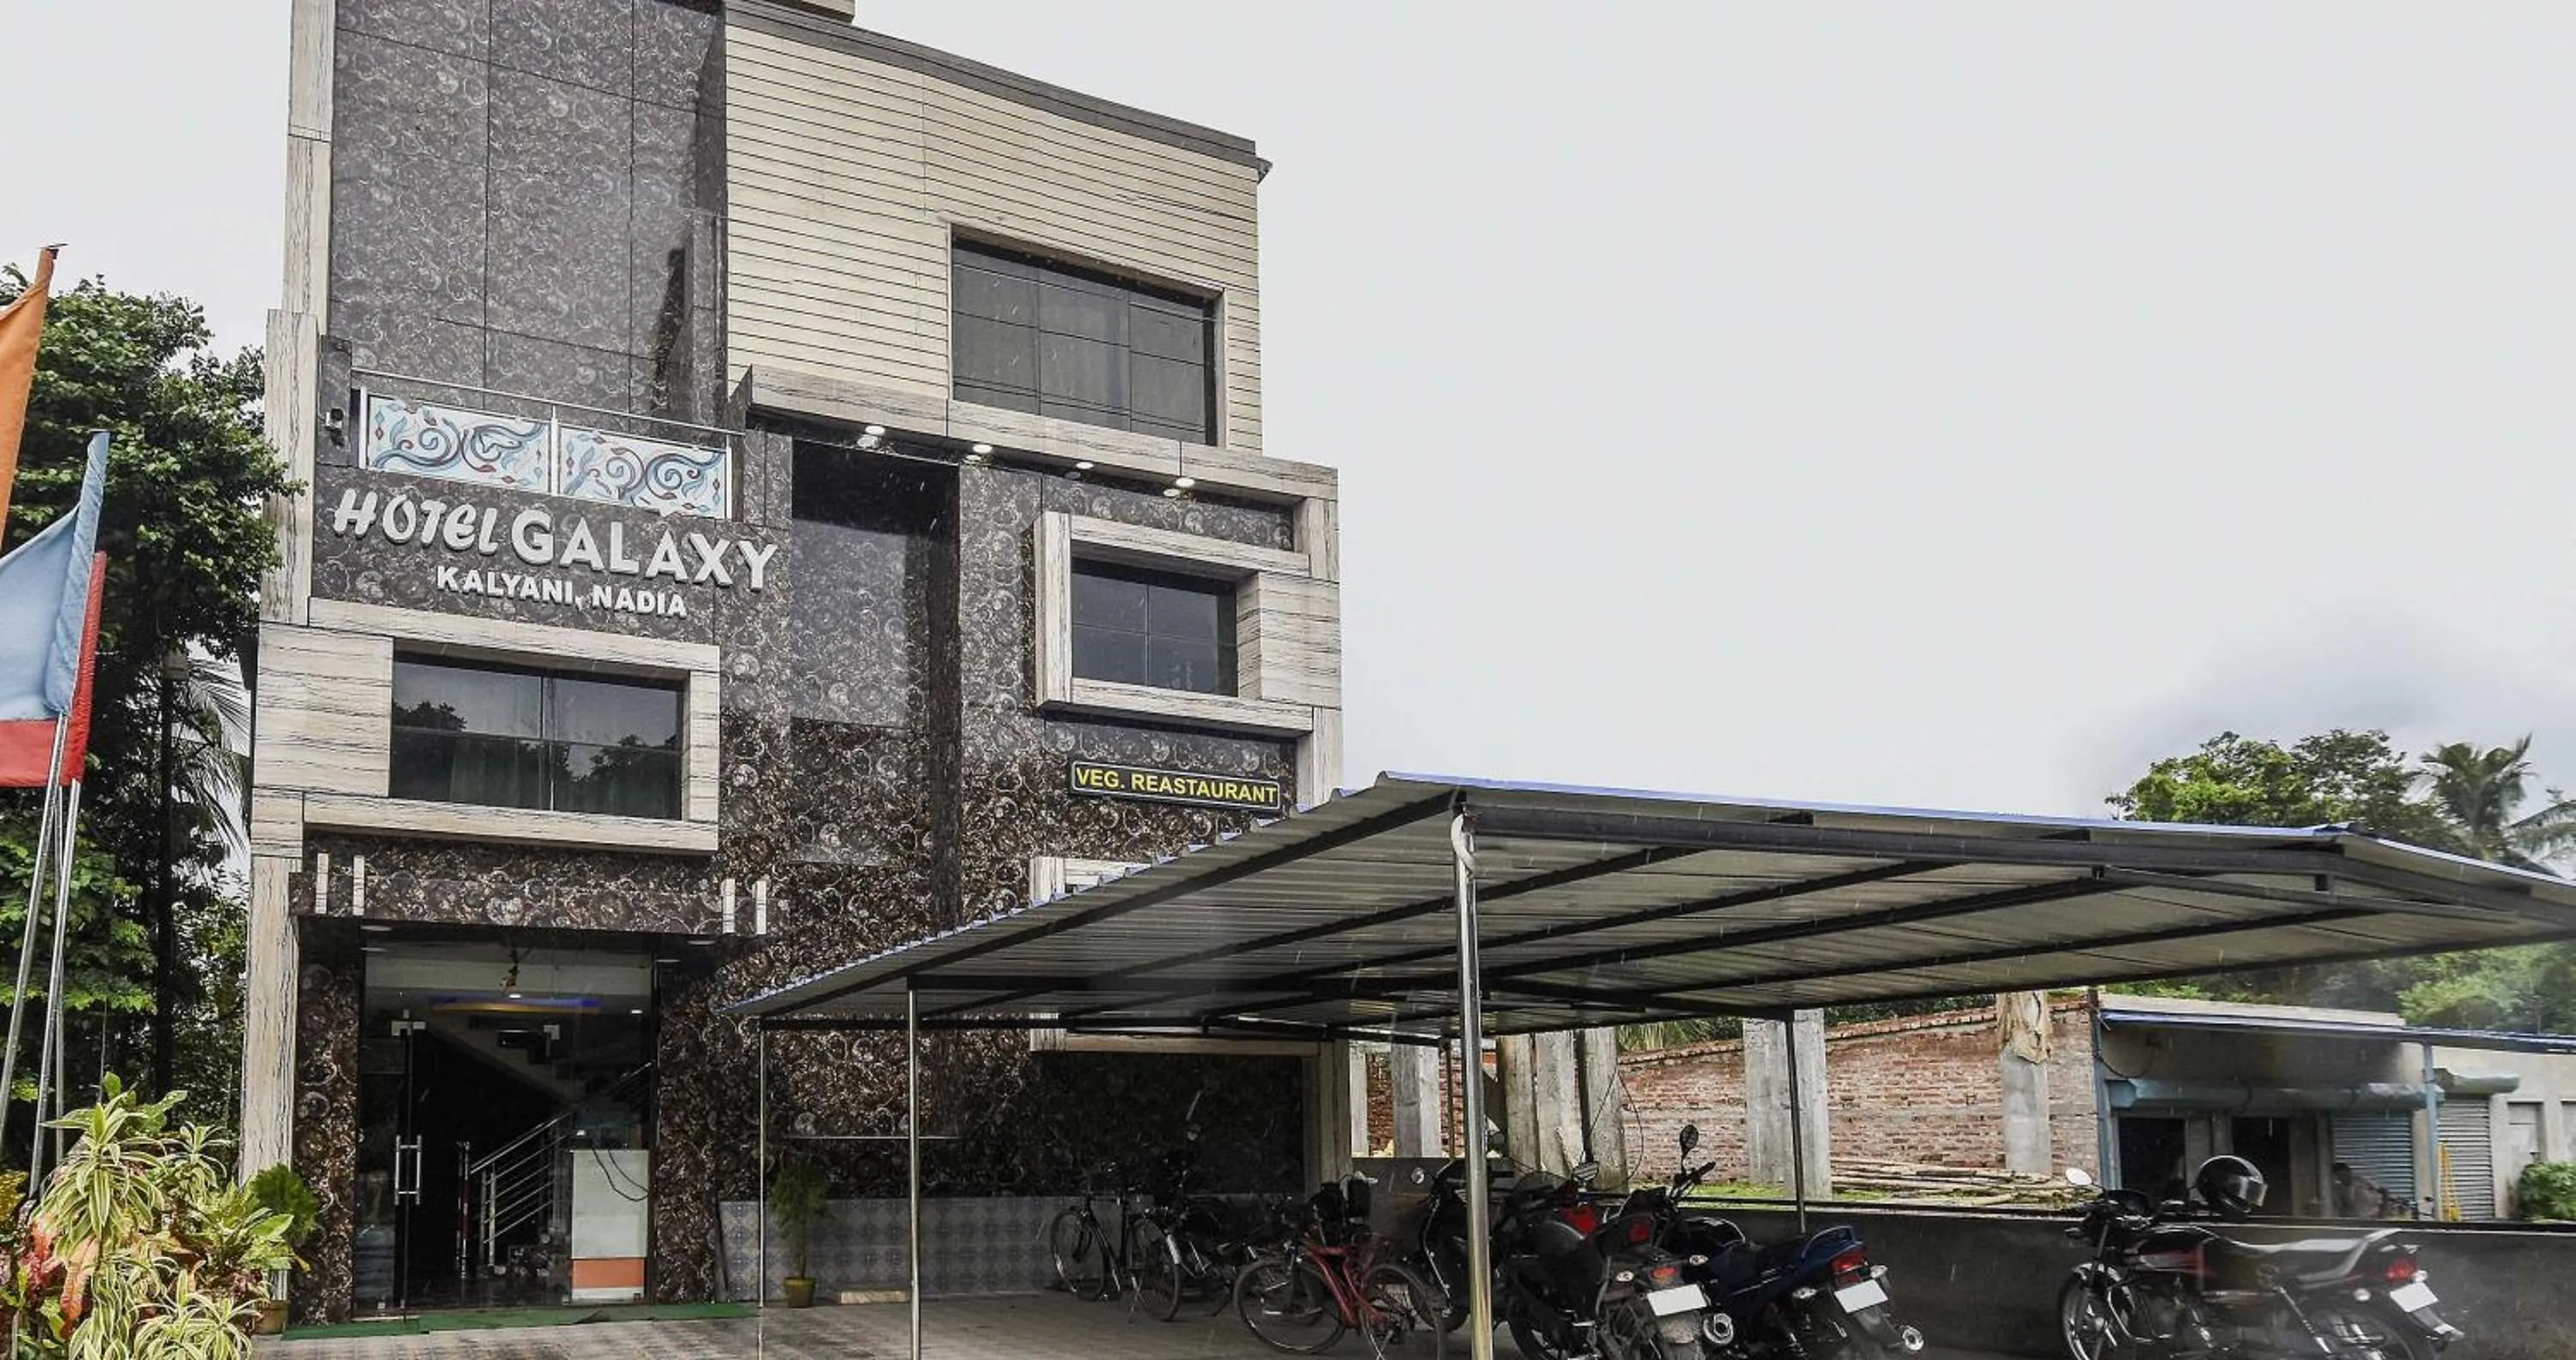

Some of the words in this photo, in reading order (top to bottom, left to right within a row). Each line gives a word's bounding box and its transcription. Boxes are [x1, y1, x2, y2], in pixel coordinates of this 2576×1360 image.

[510, 509, 777, 591] GALAXY
[436, 565, 584, 611] KALYANI,
[591, 586, 688, 618] NADIA
[1076, 767, 1126, 789] VEG.
[1131, 774, 1277, 804] REASTAURANT
